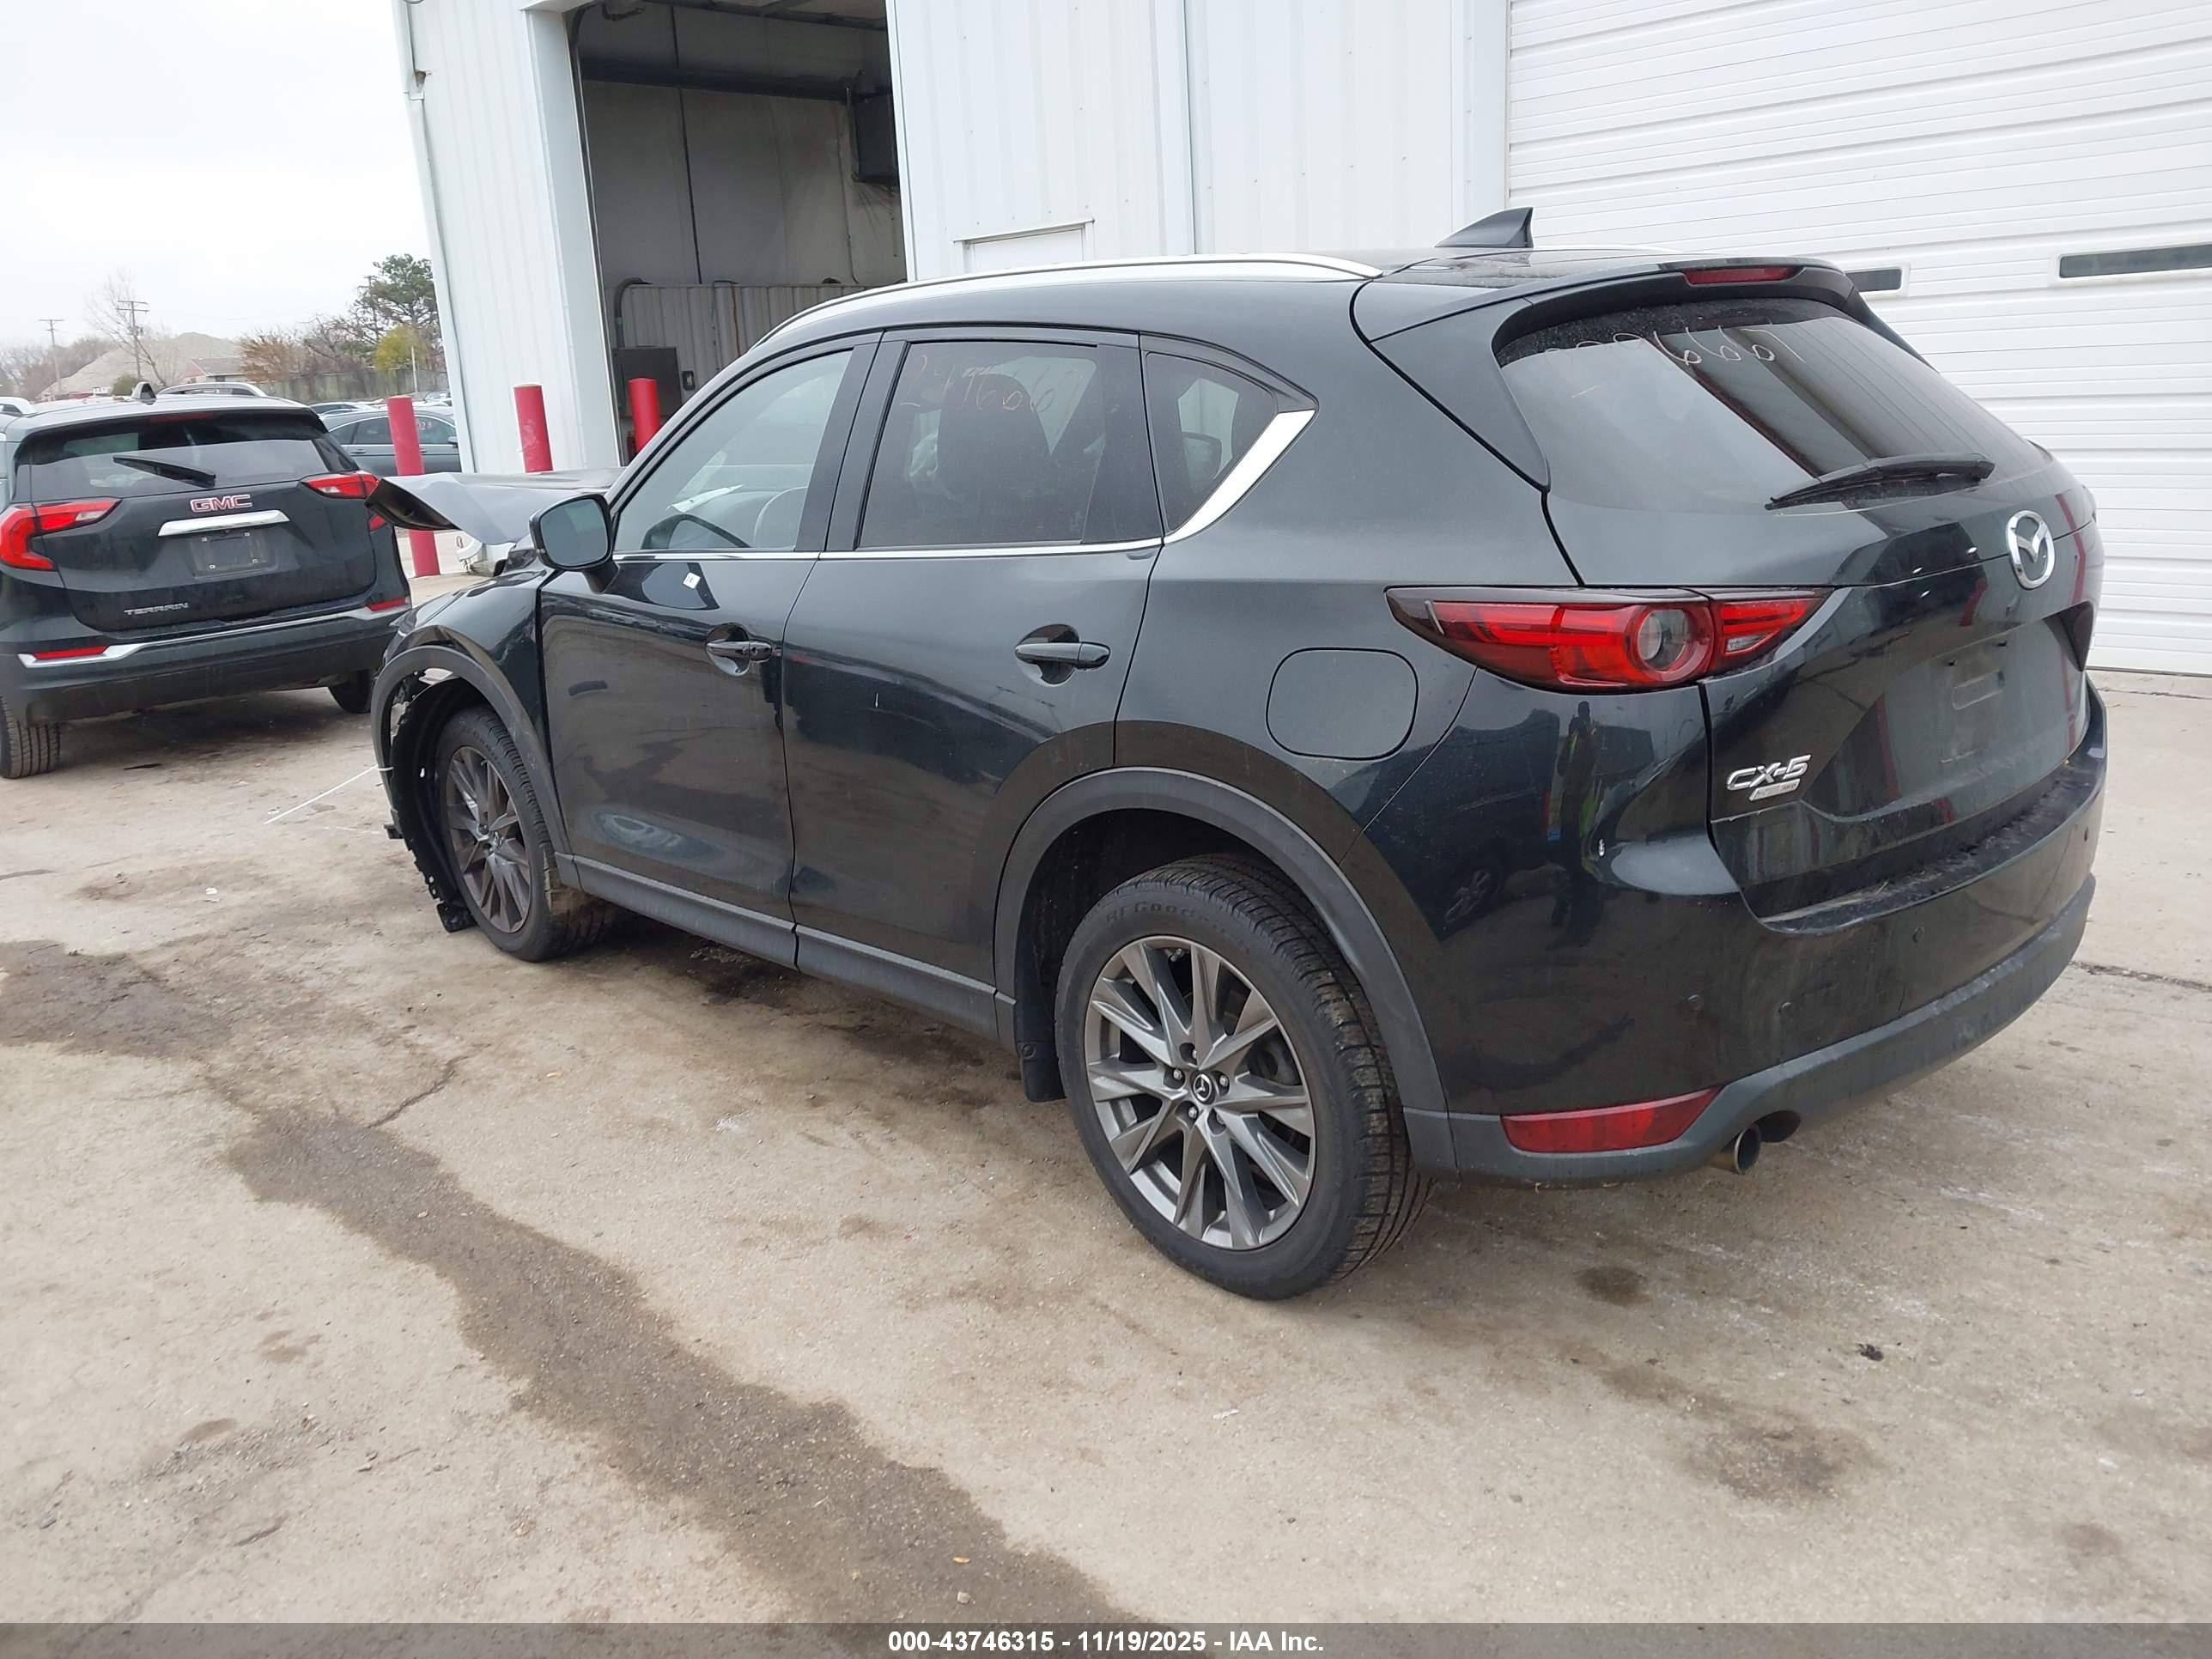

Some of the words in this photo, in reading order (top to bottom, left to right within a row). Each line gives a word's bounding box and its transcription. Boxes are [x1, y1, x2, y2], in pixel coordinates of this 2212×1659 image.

[190, 494, 253, 513] GMC
[123, 602, 189, 616] TERRAIN
[1726, 754, 1812, 791] CX-5
